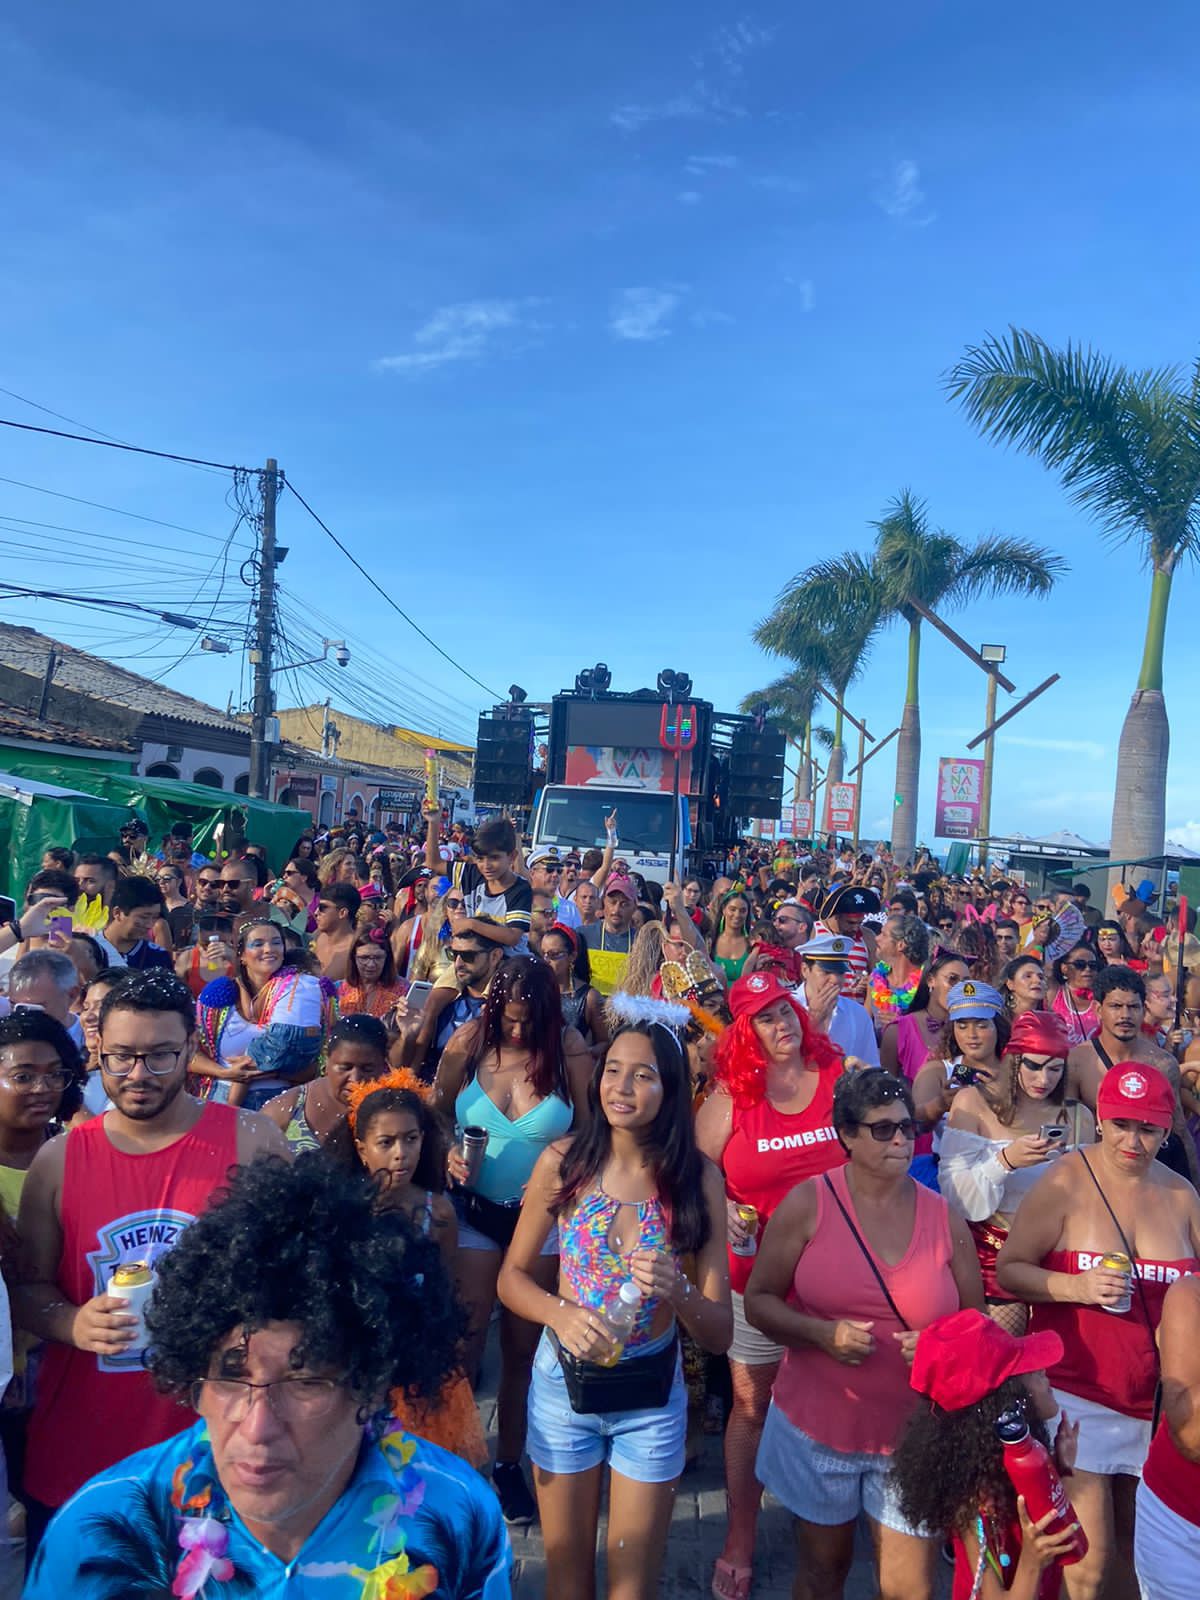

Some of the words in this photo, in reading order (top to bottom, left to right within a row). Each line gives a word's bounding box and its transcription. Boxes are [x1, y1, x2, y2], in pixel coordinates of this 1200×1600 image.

[614, 761, 650, 778] VAL
[951, 775, 972, 786] NA
[951, 785, 972, 796] VAL
[120, 1224, 178, 1250] HEINZ
